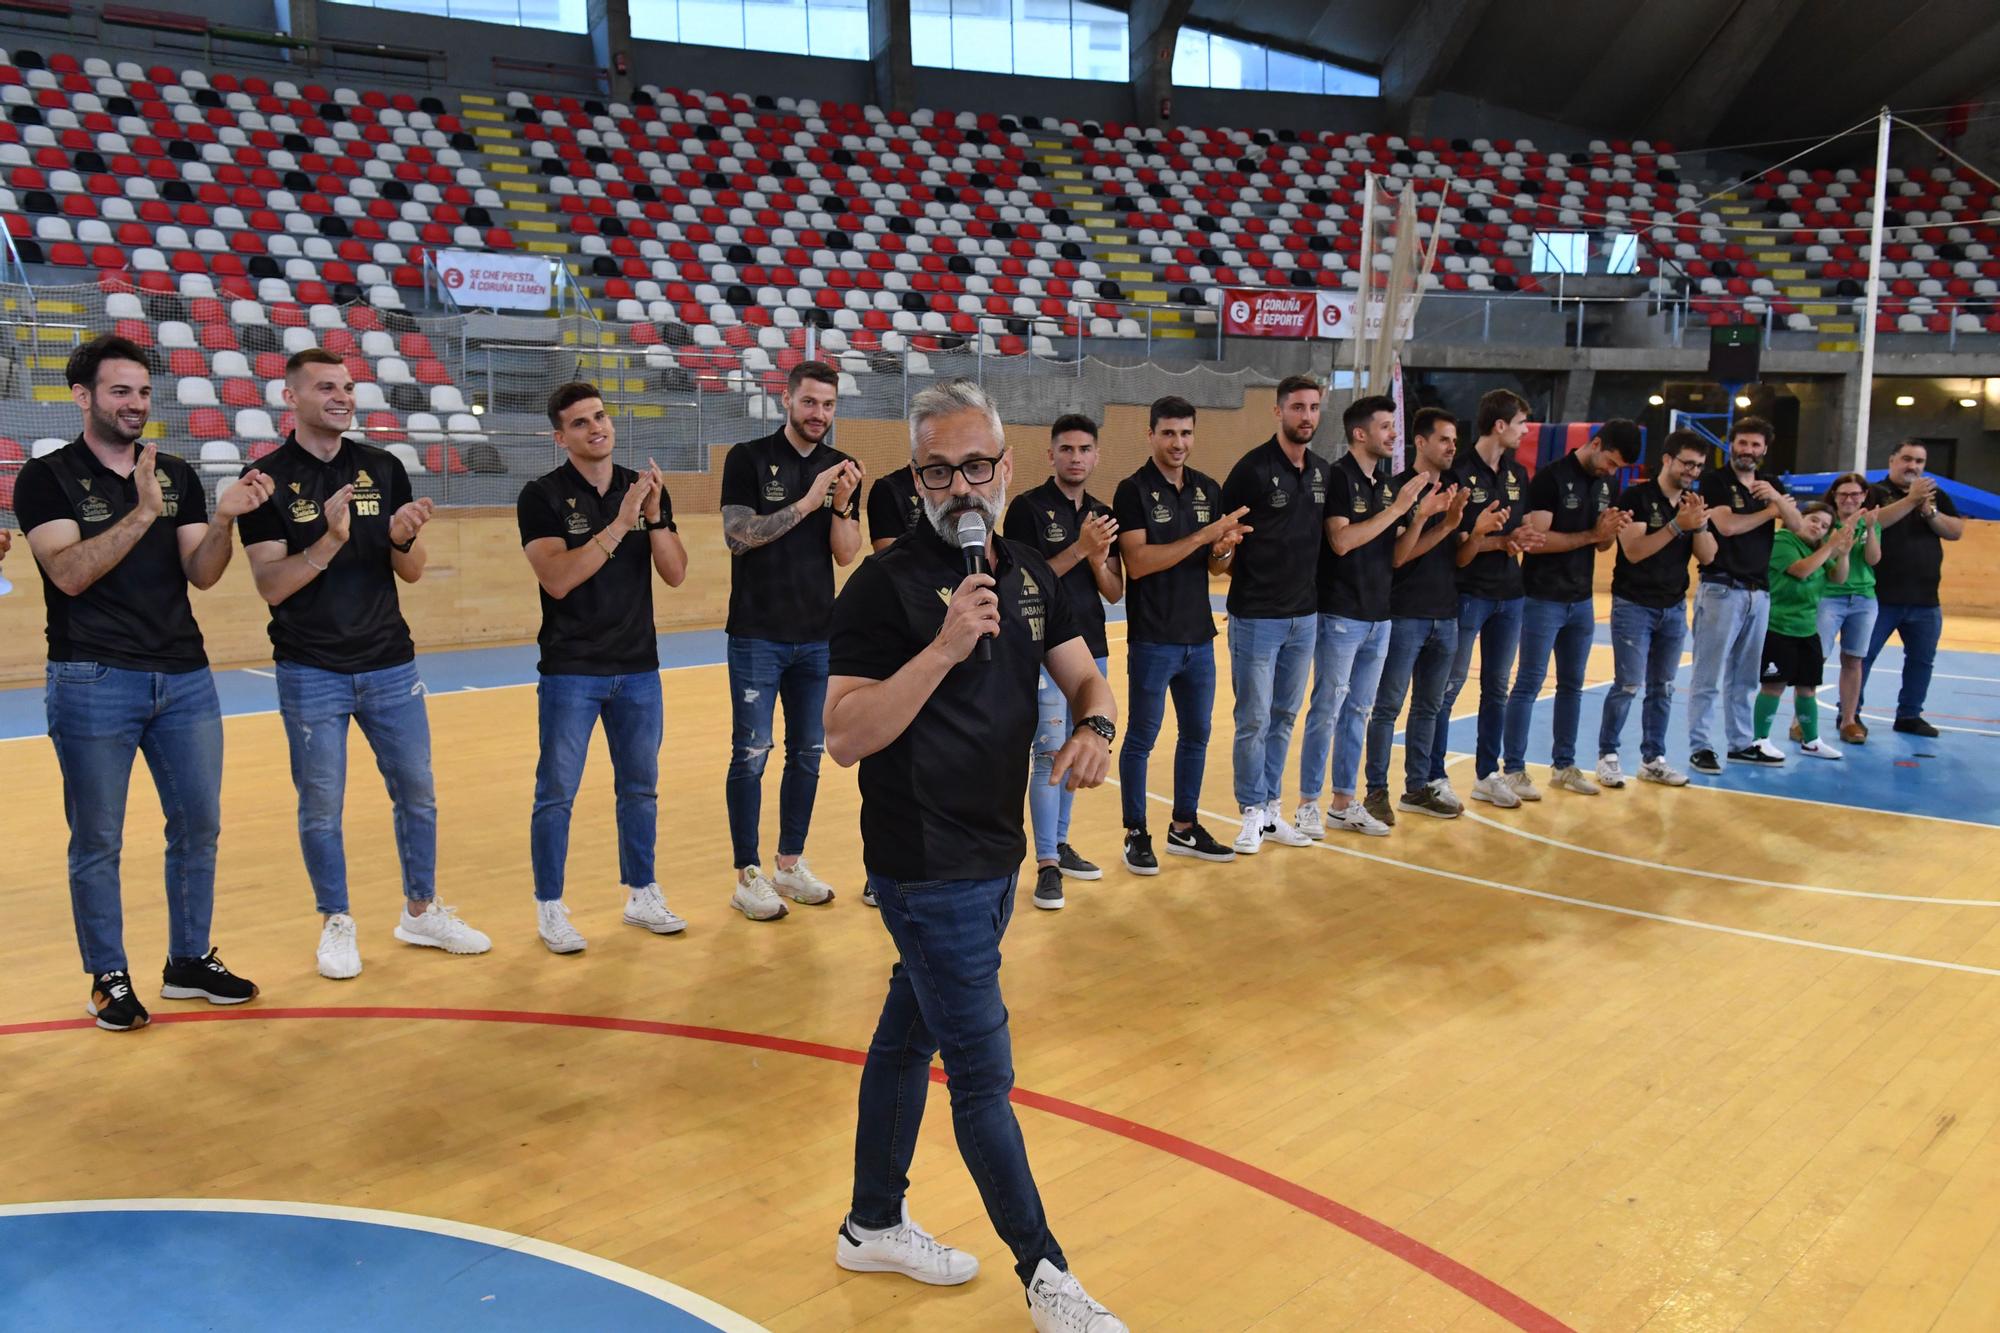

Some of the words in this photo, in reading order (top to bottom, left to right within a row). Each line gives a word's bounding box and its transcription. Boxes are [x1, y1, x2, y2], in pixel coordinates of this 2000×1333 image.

[470, 269, 480, 279] SE
[483, 270, 500, 281] CHE
[478, 280, 513, 293] CORUÑA
[1256, 298, 1263, 310] A
[1263, 297, 1300, 312] CORUÑA
[1263, 314, 1304, 326] DEPORTE
[356, 501, 380, 516] HG
